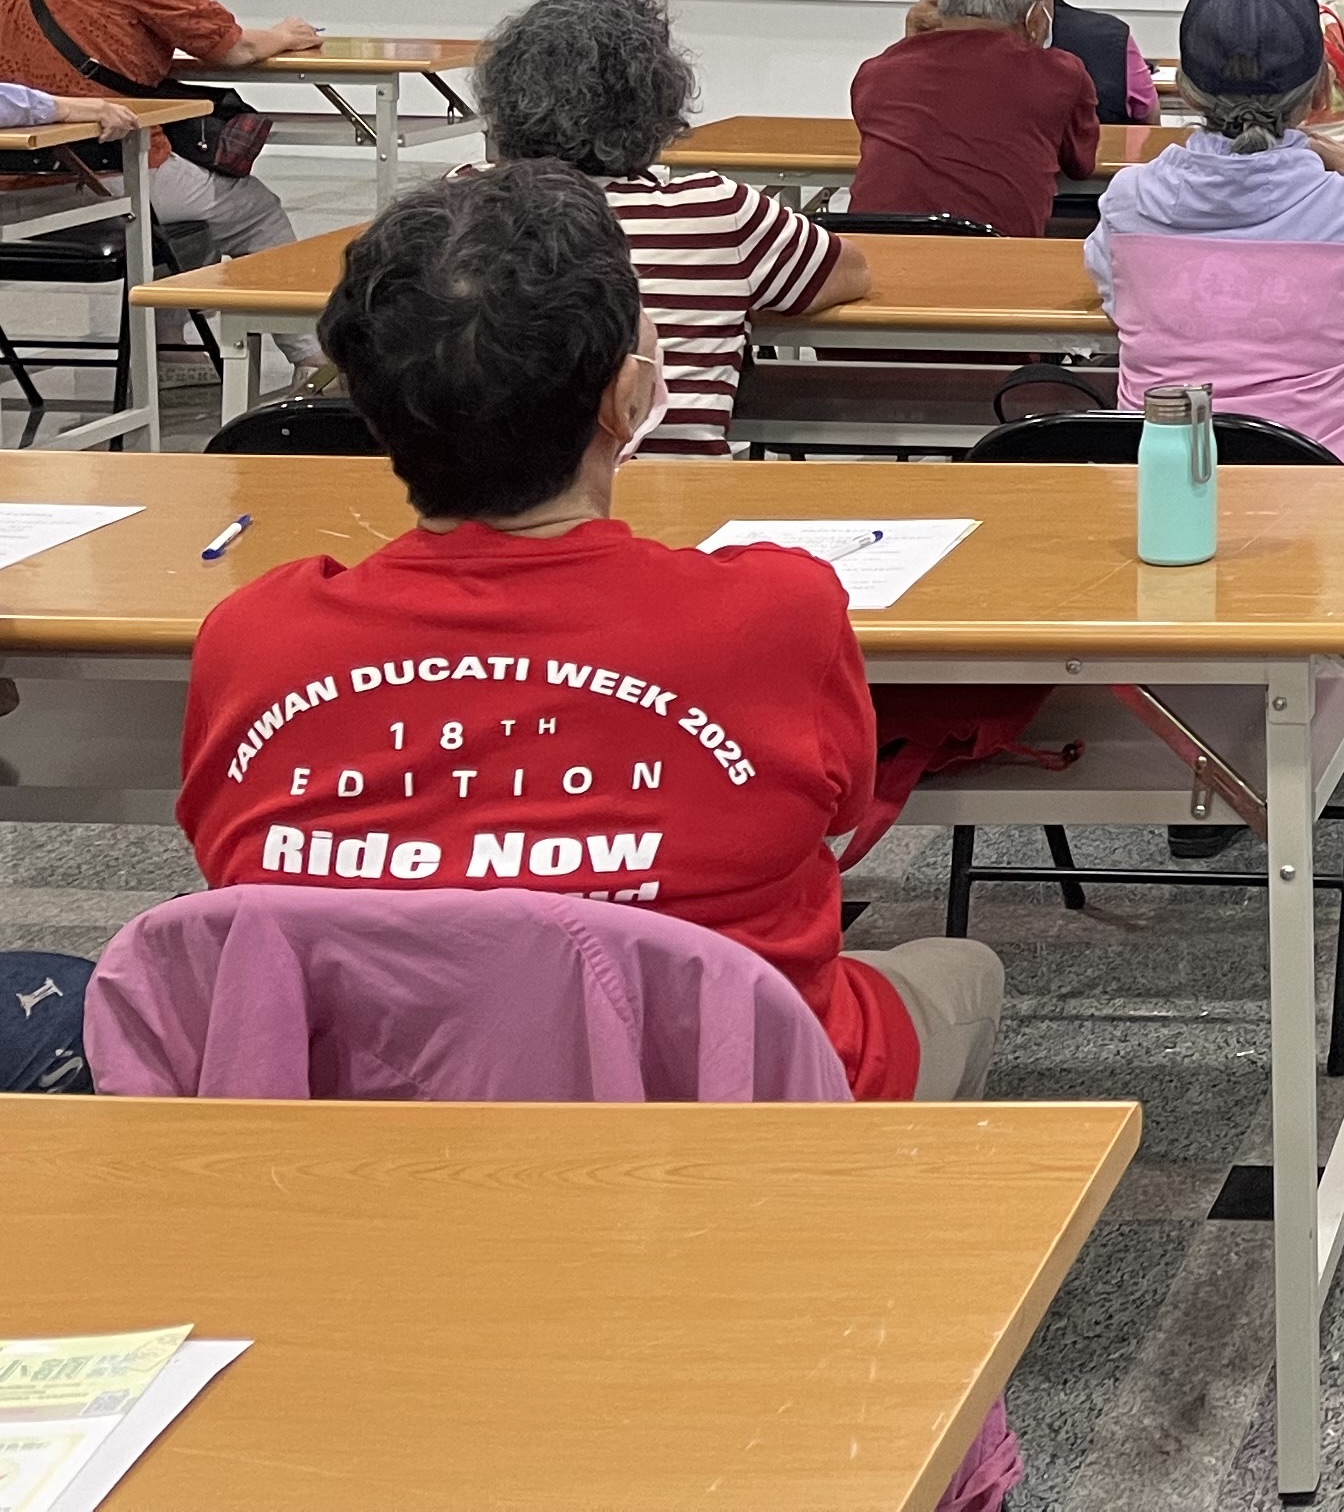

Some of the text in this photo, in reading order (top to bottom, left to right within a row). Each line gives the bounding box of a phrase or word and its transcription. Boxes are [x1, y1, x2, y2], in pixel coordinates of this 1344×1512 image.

[227, 656, 756, 787] TAIWAN DUCATI WEEK 2025
[289, 761, 663, 798] EDITION
[262, 824, 663, 879] Ride Now
